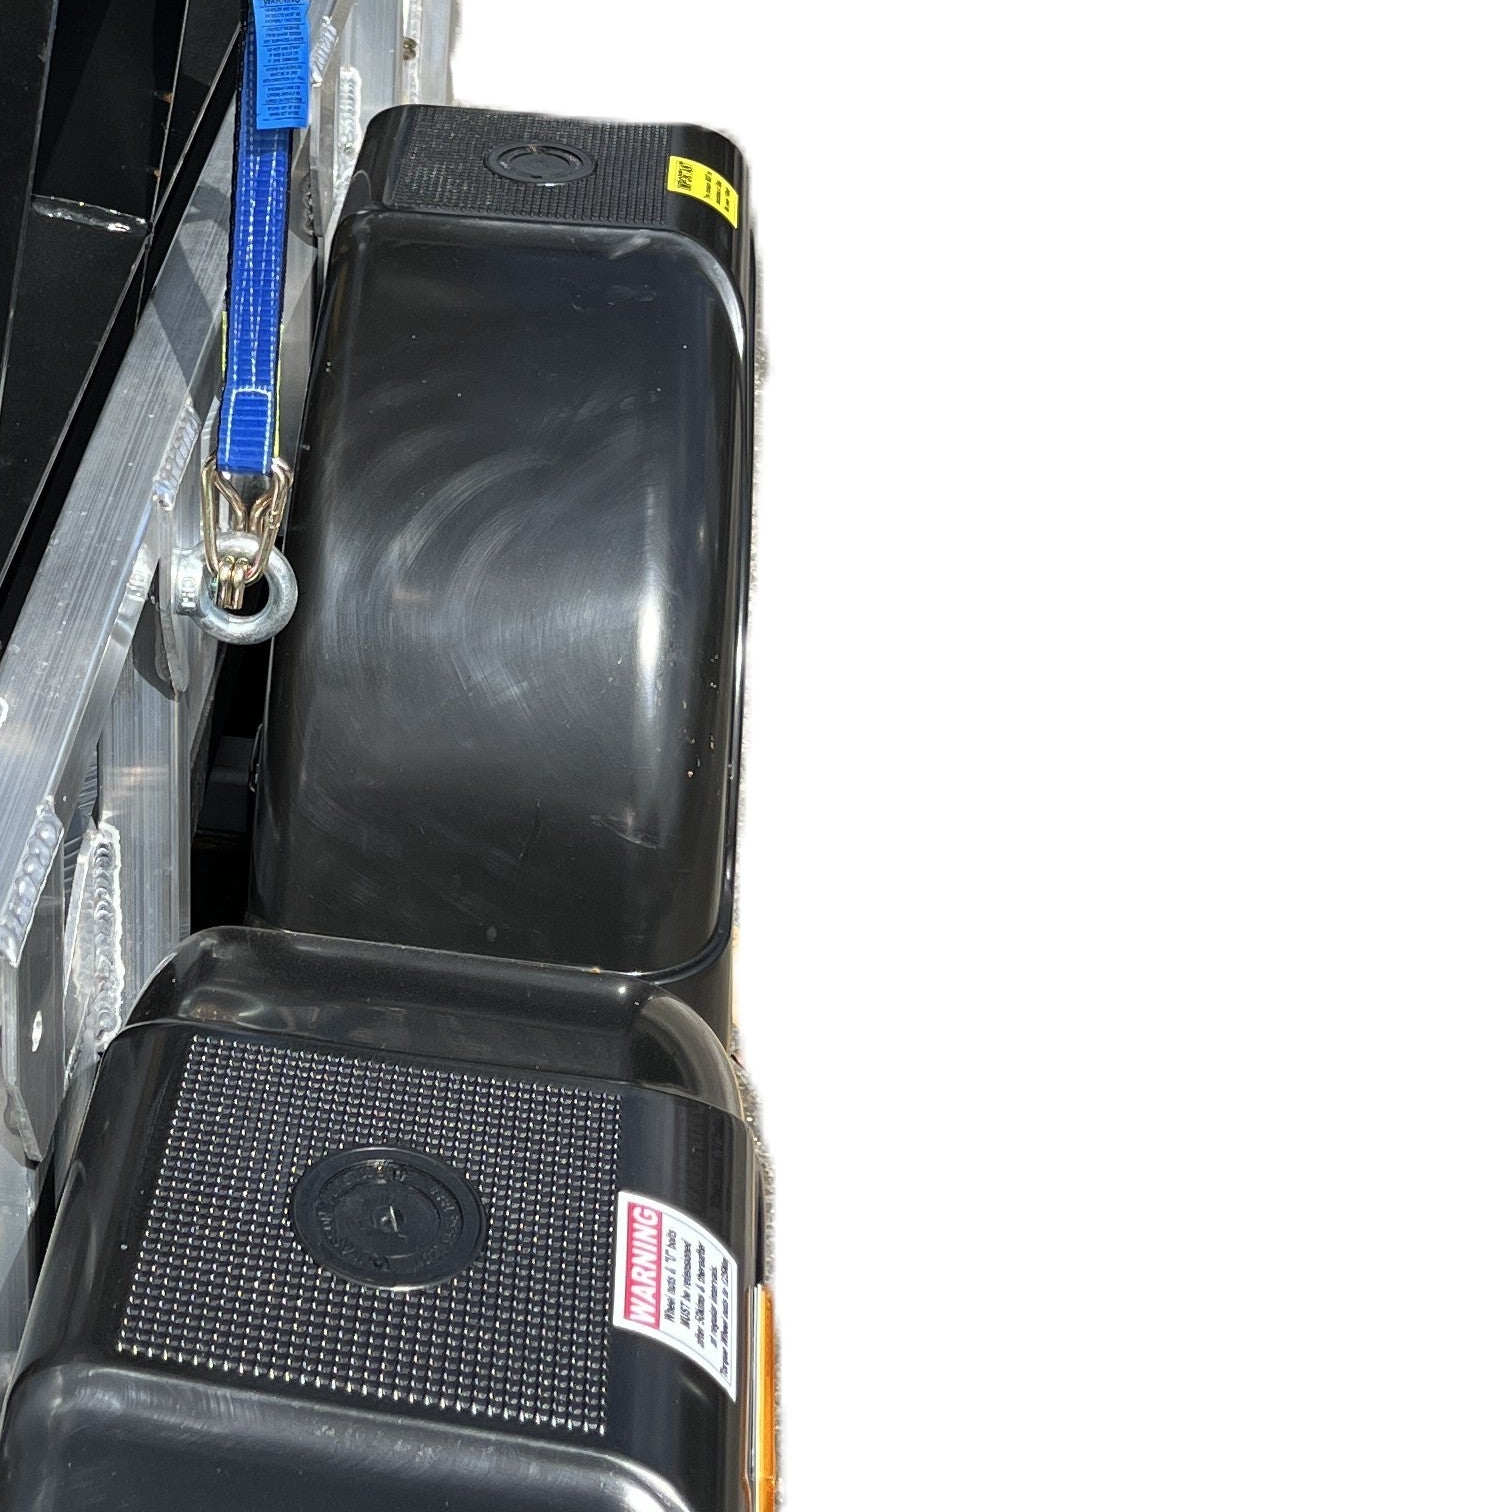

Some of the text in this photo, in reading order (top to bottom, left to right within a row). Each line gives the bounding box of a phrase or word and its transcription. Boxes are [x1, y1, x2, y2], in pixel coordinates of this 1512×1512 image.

[629, 1206, 659, 1325] WARNING
[696, 1241, 705, 1284] thereafter
[667, 1276, 676, 1295] nuts
[682, 1291, 691, 1303] be
[664, 1294, 675, 1323] Wheel
[680, 1300, 690, 1329] MUST
[710, 1304, 719, 1336] regular
[695, 1325, 705, 1348] after
